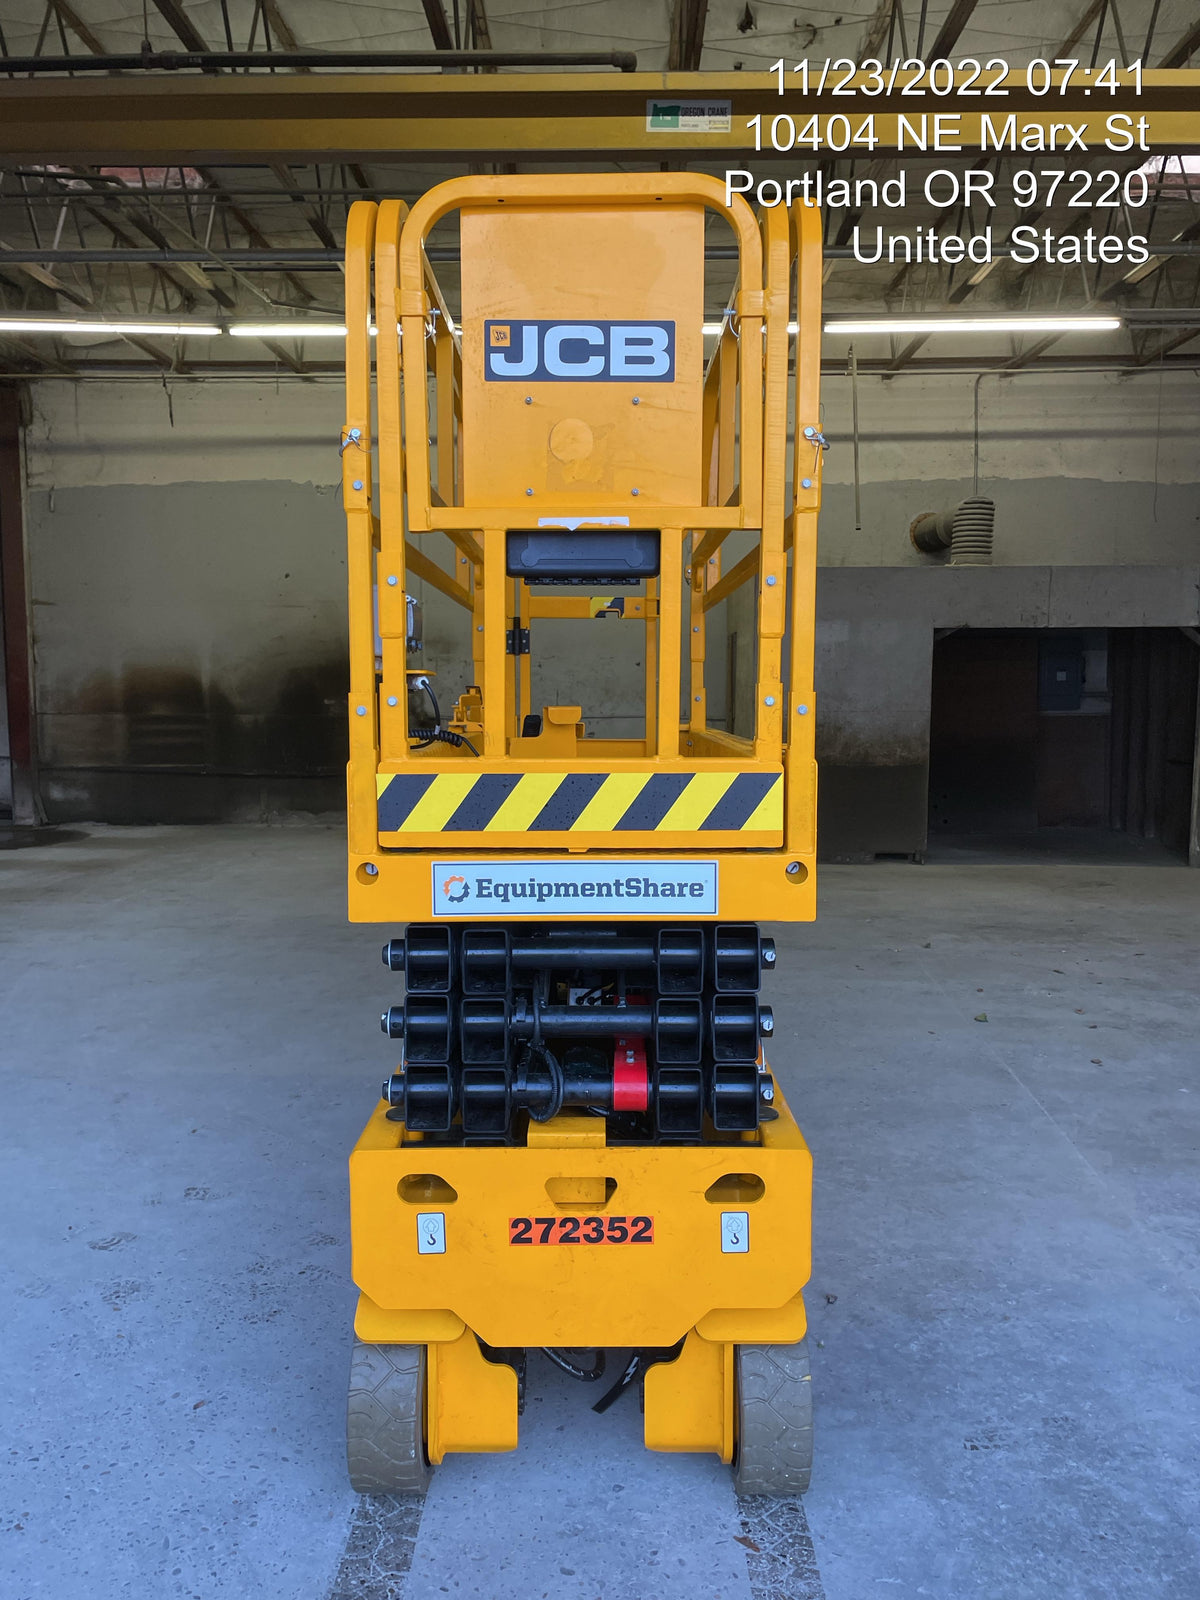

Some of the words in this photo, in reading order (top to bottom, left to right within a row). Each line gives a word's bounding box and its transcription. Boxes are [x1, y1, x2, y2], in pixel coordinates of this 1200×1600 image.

[681, 106, 705, 117] OREGON
[707, 106, 728, 117] CRANE
[489, 325, 671, 376] JCB
[475, 878, 704, 902] EquipmentShare
[510, 1216, 653, 1244] 272352
